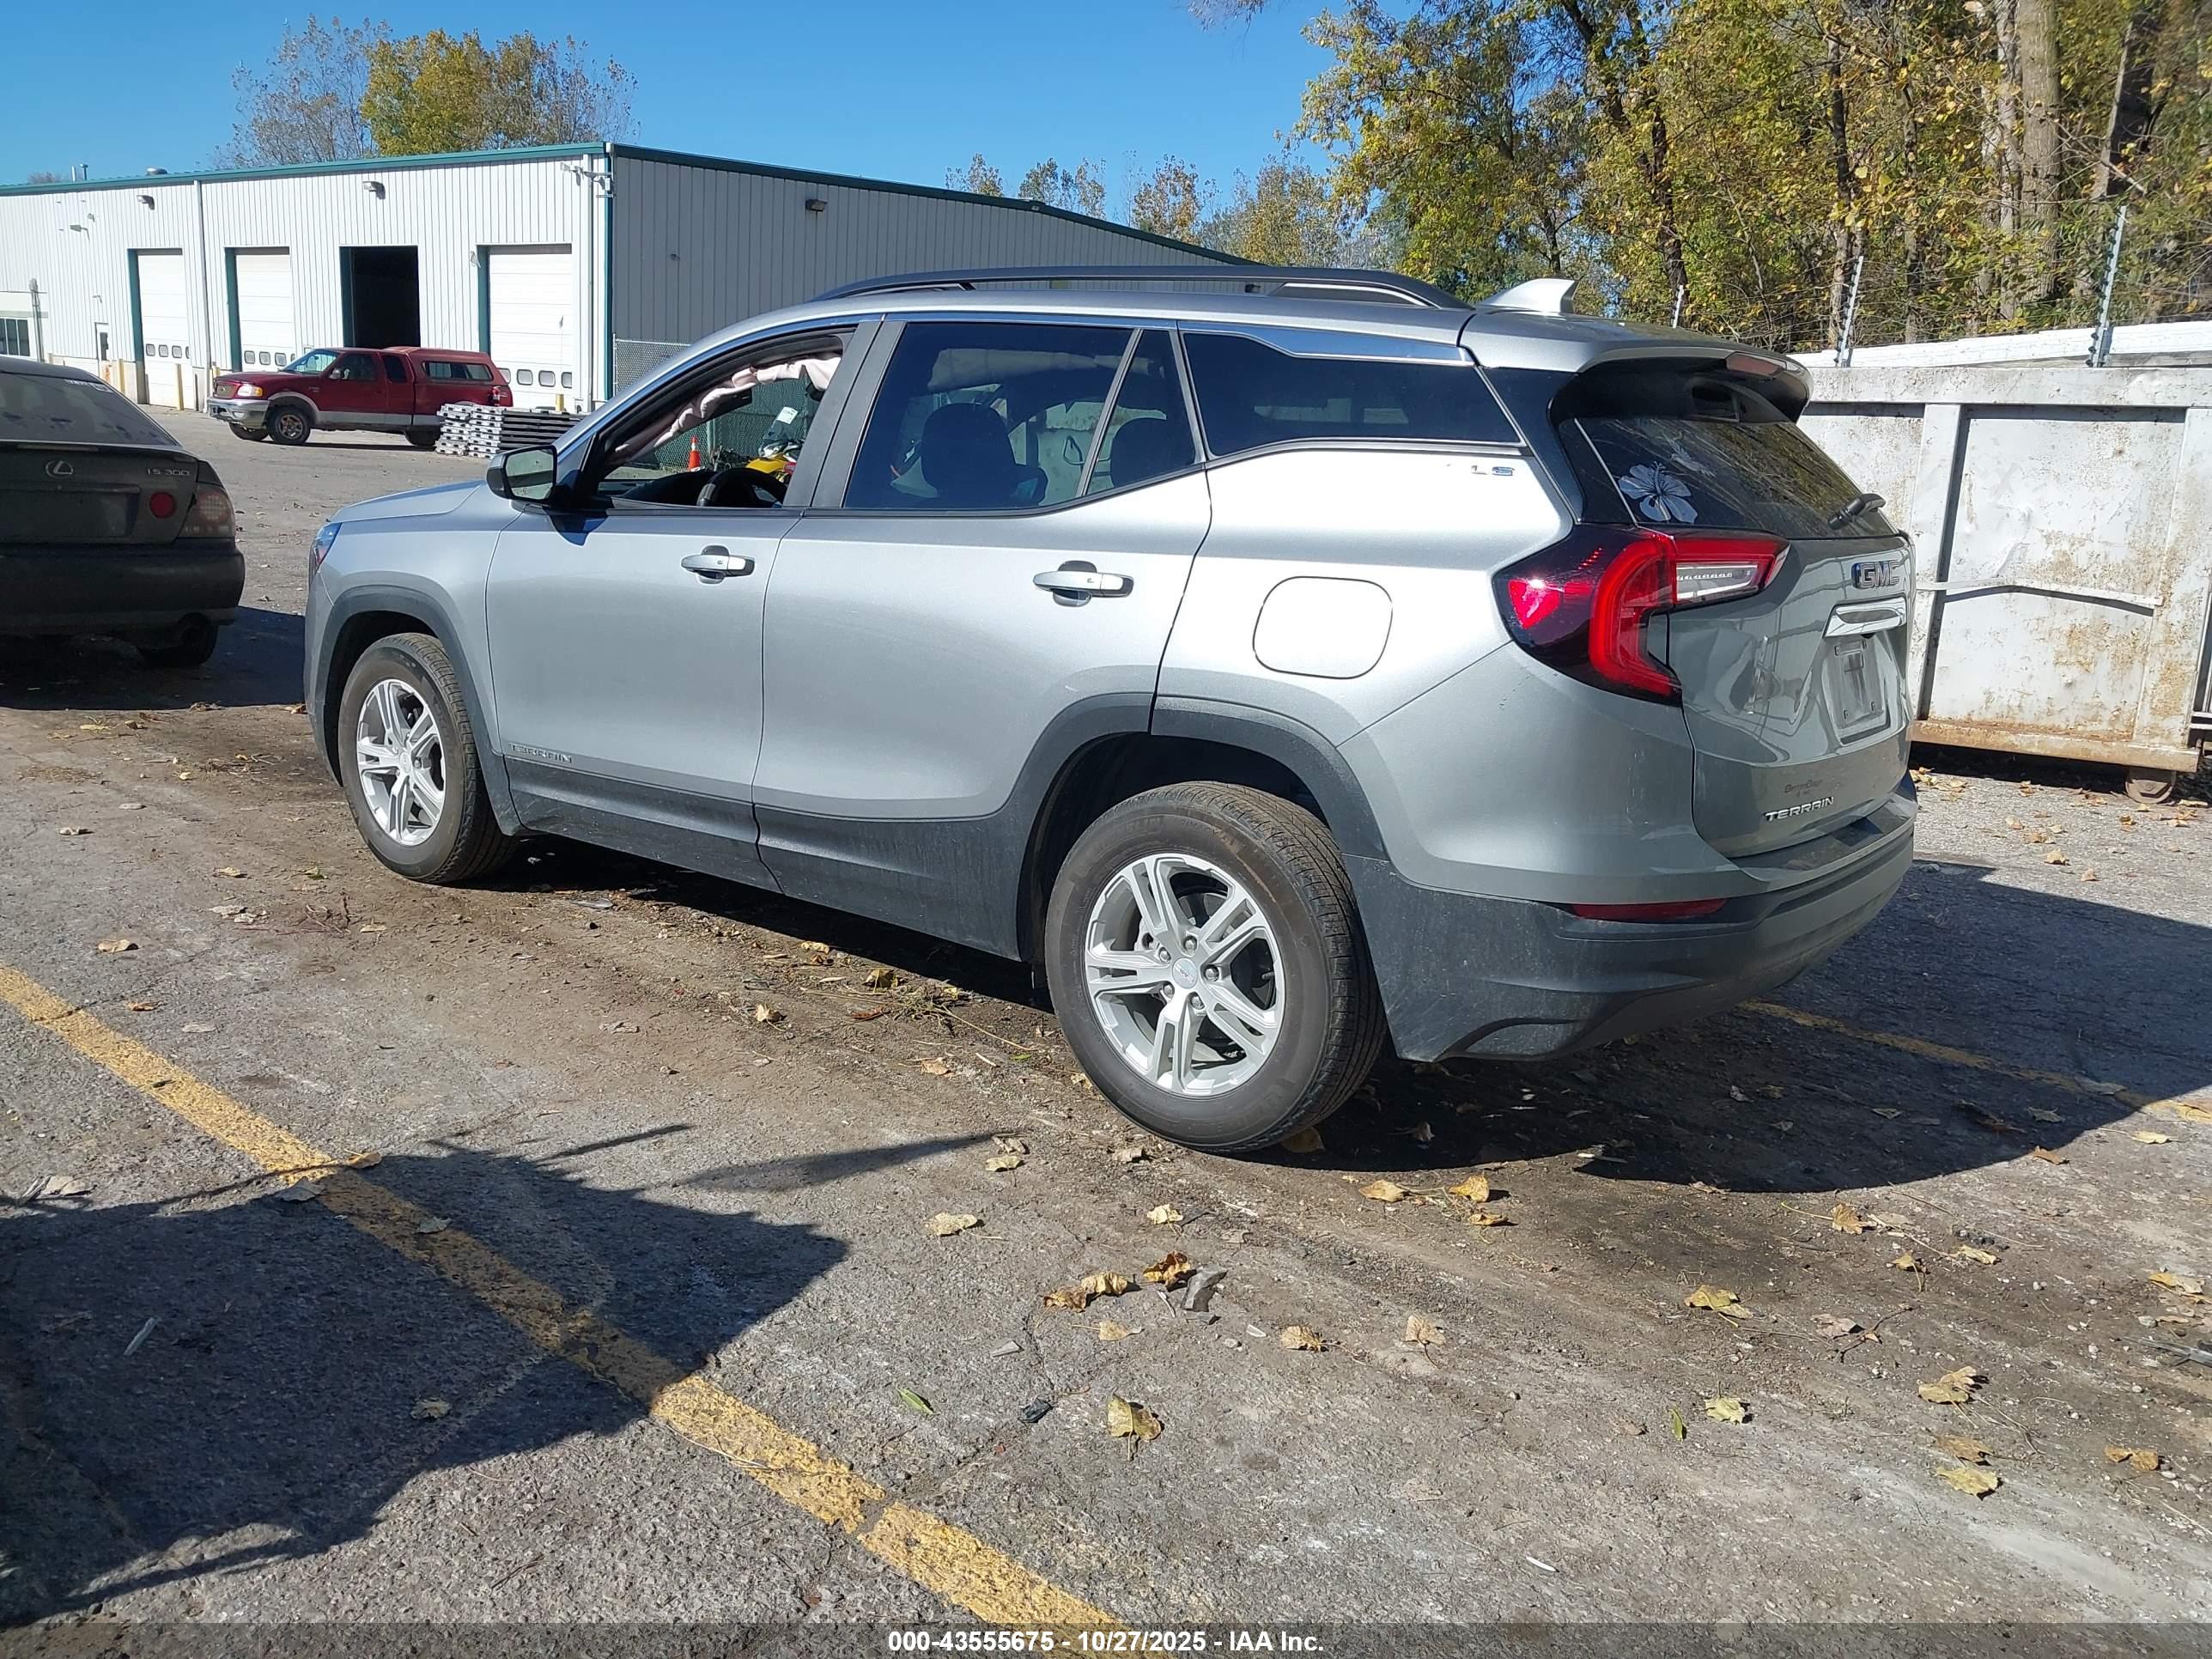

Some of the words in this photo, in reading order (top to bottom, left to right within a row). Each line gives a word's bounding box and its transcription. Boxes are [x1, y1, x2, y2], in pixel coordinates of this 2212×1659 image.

[1858, 560, 1900, 587] GMC
[507, 742, 573, 763] TERRAIN
[1765, 796, 1834, 822] TERRAIN
